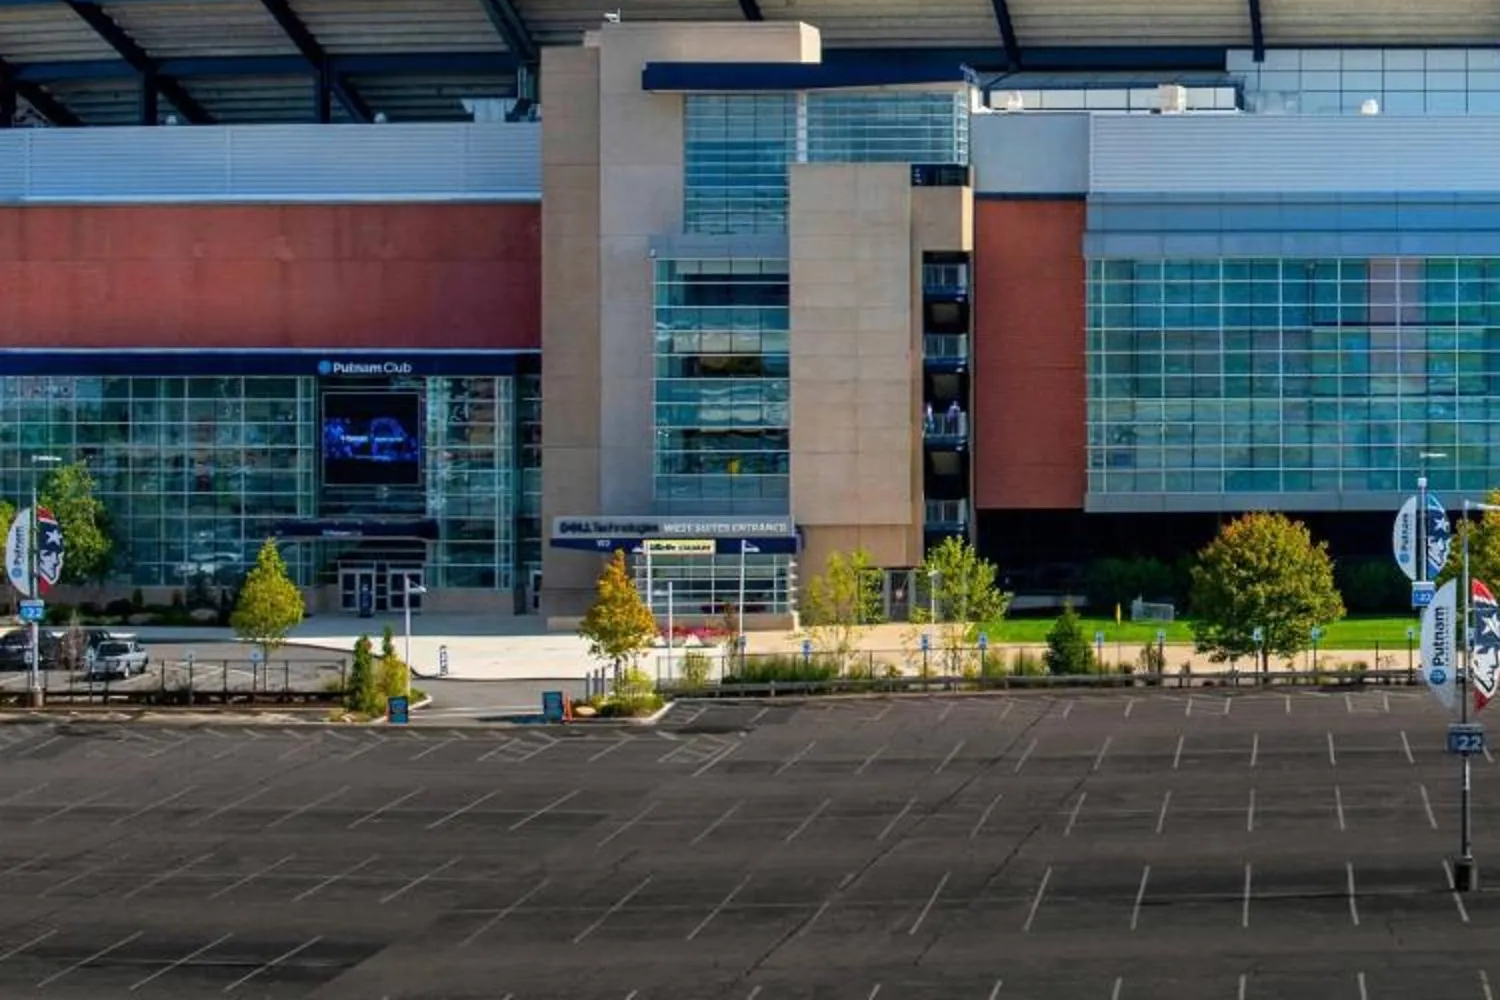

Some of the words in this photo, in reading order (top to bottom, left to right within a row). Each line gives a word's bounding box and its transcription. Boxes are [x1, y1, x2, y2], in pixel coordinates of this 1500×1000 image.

[333, 361, 383, 373] Putnam
[383, 361, 413, 373] Club
[1432, 606, 1445, 666] Putnam
[1459, 736, 1481, 750] 22
